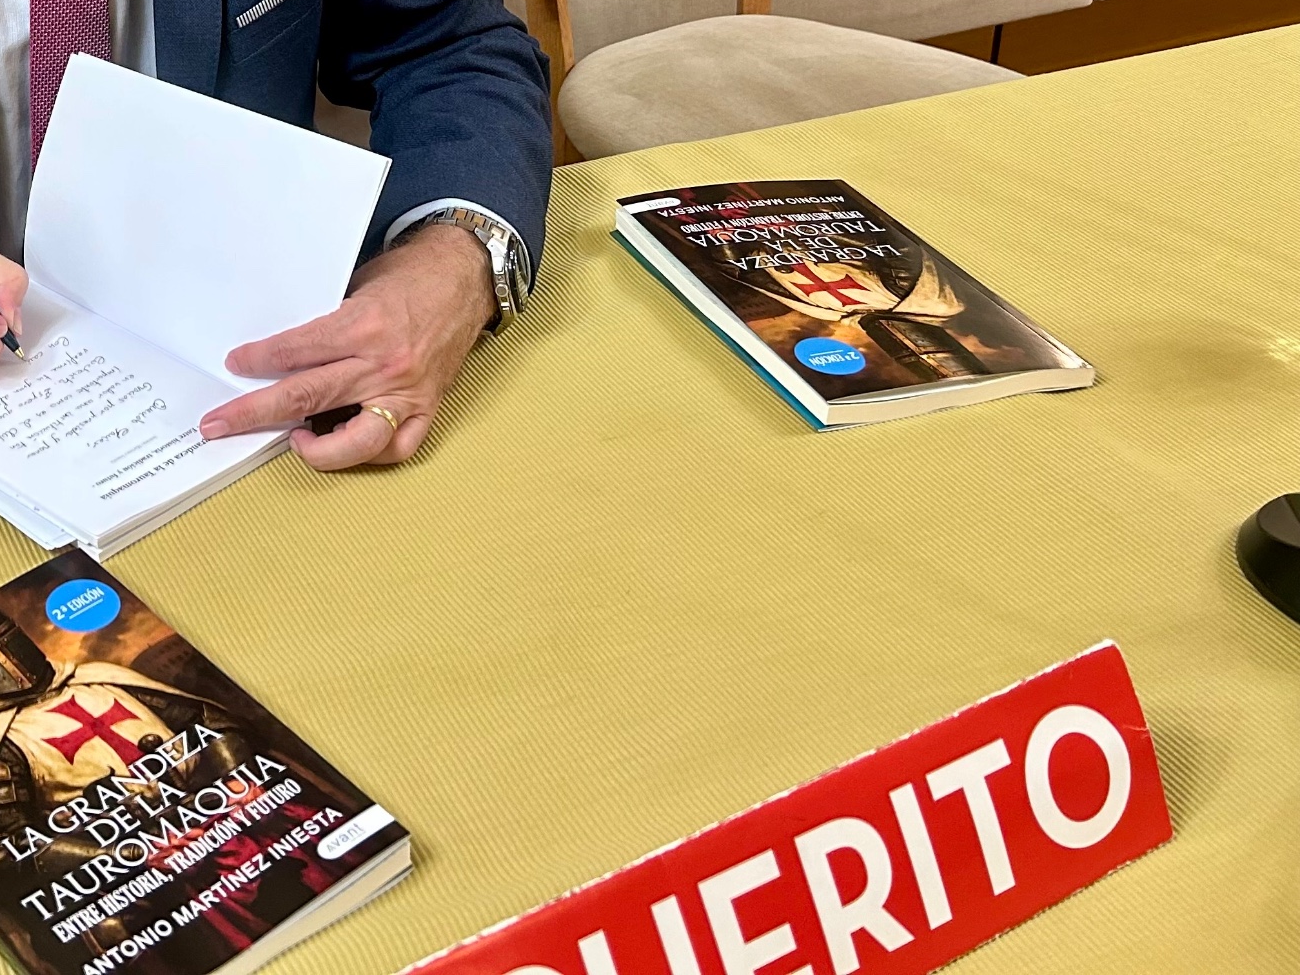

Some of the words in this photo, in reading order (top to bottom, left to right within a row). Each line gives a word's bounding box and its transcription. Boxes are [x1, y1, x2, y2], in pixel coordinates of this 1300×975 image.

[716, 198, 784, 212] MARTÍNEZ
[786, 195, 845, 205] ANTONIO
[657, 204, 714, 218] INIESTA
[781, 211, 832, 224] HISTORIA,
[831, 210, 865, 220] ENTRE
[680, 219, 722, 233] FUTURO
[730, 214, 782, 229] TRADICIÓN
[686, 220, 886, 248] TAUROMAQUIA
[766, 238, 801, 252] LA
[800, 236, 838, 250] DE
[861, 244, 902, 257] LA
[728, 247, 867, 271] GRANDEZA
[48, 336, 69, 349] Con
[13, 378, 32, 393] gran
[118, 382, 153, 403] Gracias
[18, 387, 52, 407] Espero
[49, 394, 72, 408] como
[75, 399, 94, 410] una
[100, 399, 115, 415] por
[51, 432, 61, 444] y
[51, 605, 68, 621] 2ª
[66, 586, 105, 612] EDICIÓN
[1, 826, 54, 862] LA
[48, 724, 224, 833] GRANDEZA
[85, 805, 141, 848] DE
[134, 782, 187, 818] LA
[20, 755, 287, 921] TAUROMAQUIA
[500, 703, 1132, 975] ERITO
[51, 903, 106, 944] ENTRE
[98, 868, 174, 919] HISTORIA,
[163, 816, 244, 875] TRADICIÓN
[232, 808, 254, 828] Y
[244, 777, 302, 822] FUTURO
[82, 919, 173, 975] ANTONIO
[171, 852, 273, 927] MARTÍNEZ
[267, 807, 344, 861] INIESTA
